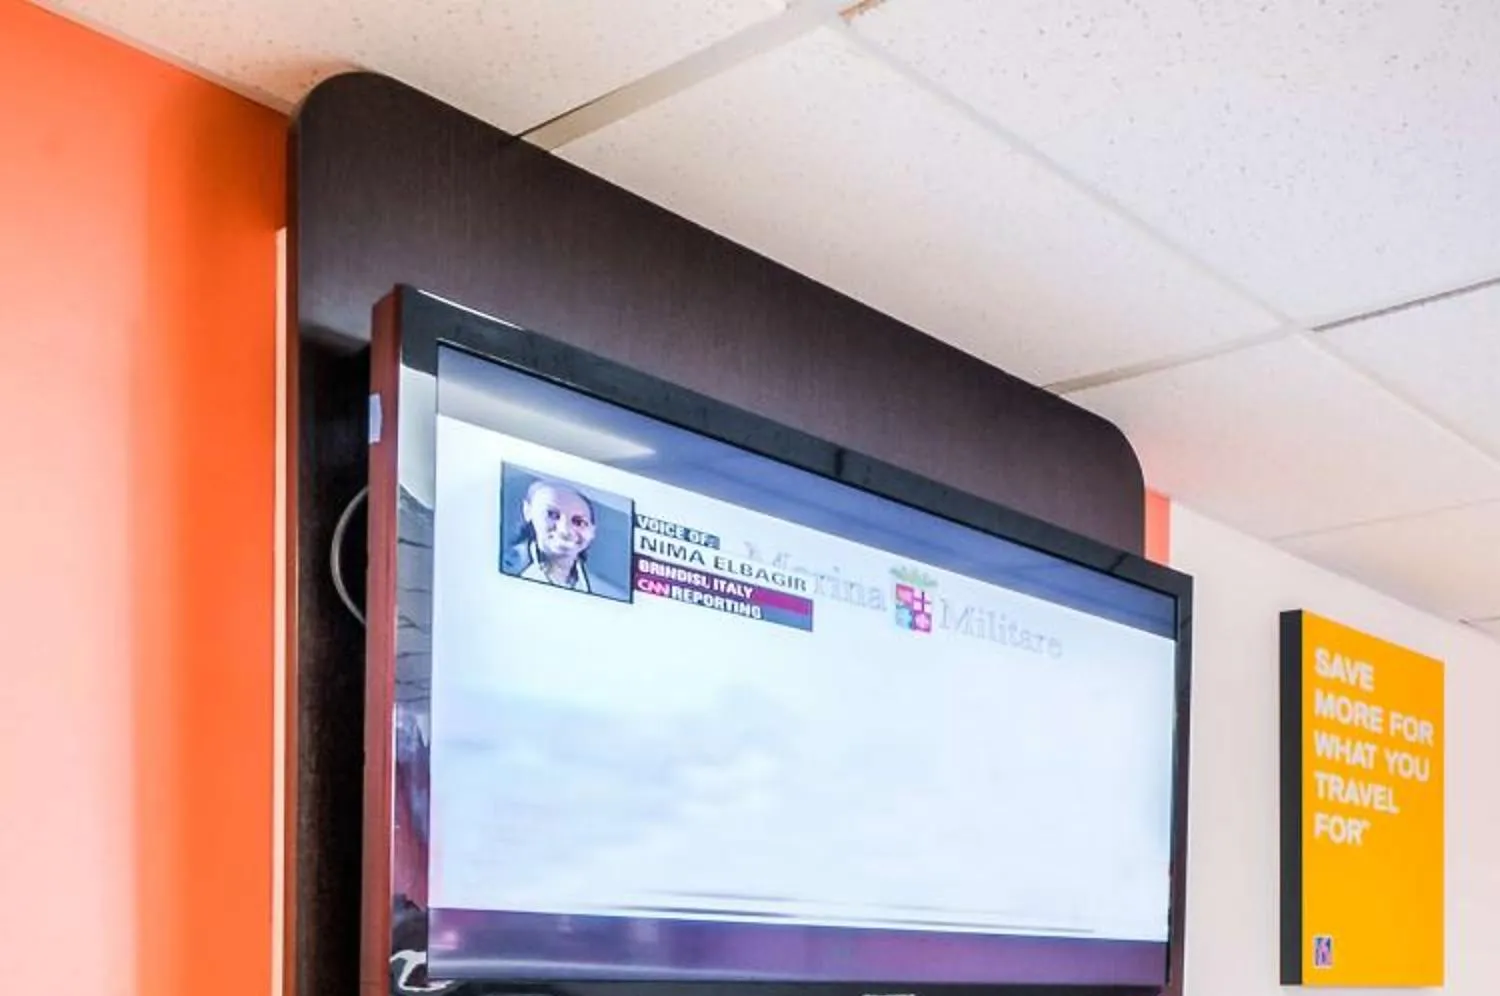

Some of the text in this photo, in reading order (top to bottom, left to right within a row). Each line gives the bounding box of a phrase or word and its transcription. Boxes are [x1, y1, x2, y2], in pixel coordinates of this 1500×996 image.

[637, 515, 685, 540] VOICE
[640, 536, 807, 592] NIMA ELBAGIR
[637, 578, 762, 619] CNN REPORTING
[713, 579, 754, 600] ITALY
[938, 597, 1064, 659] Militare
[1314, 649, 1374, 690] SAVE
[1314, 690, 1434, 746] MORE FOR
[1313, 731, 1430, 782] WHAT YOU
[1314, 772, 1399, 814] TRAVEL
